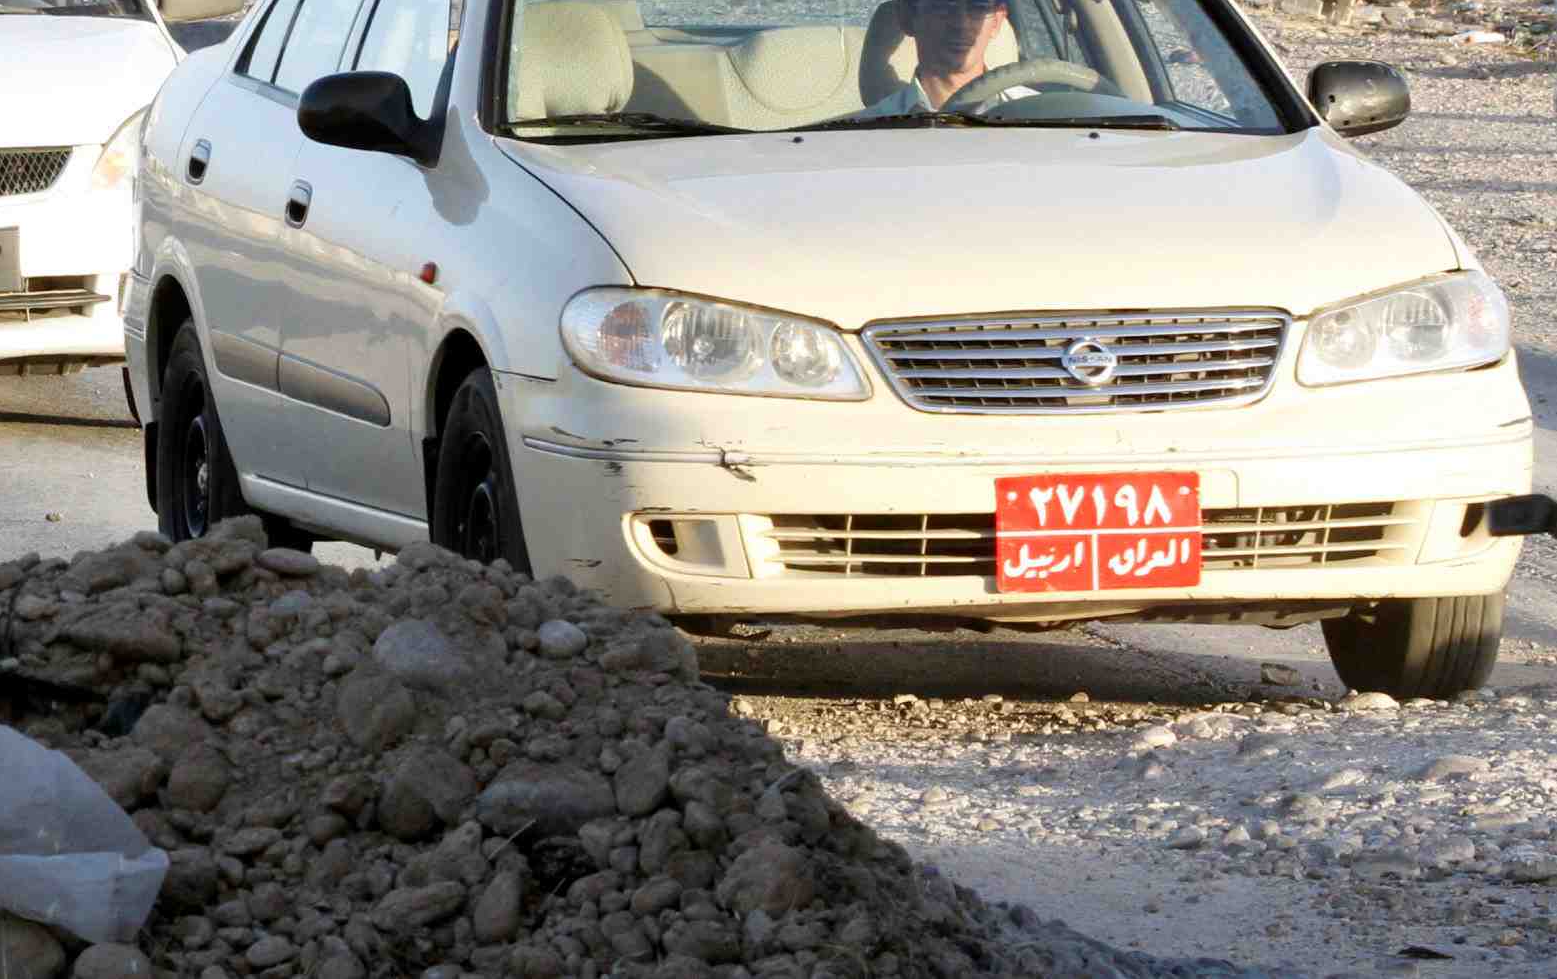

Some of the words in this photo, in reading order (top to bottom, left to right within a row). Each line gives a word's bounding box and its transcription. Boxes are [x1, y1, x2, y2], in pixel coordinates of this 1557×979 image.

[1028, 483, 1173, 527] ٢٧١٩٨
[1003, 541, 1085, 579] اربيل
[1107, 537, 1191, 576] العراق
